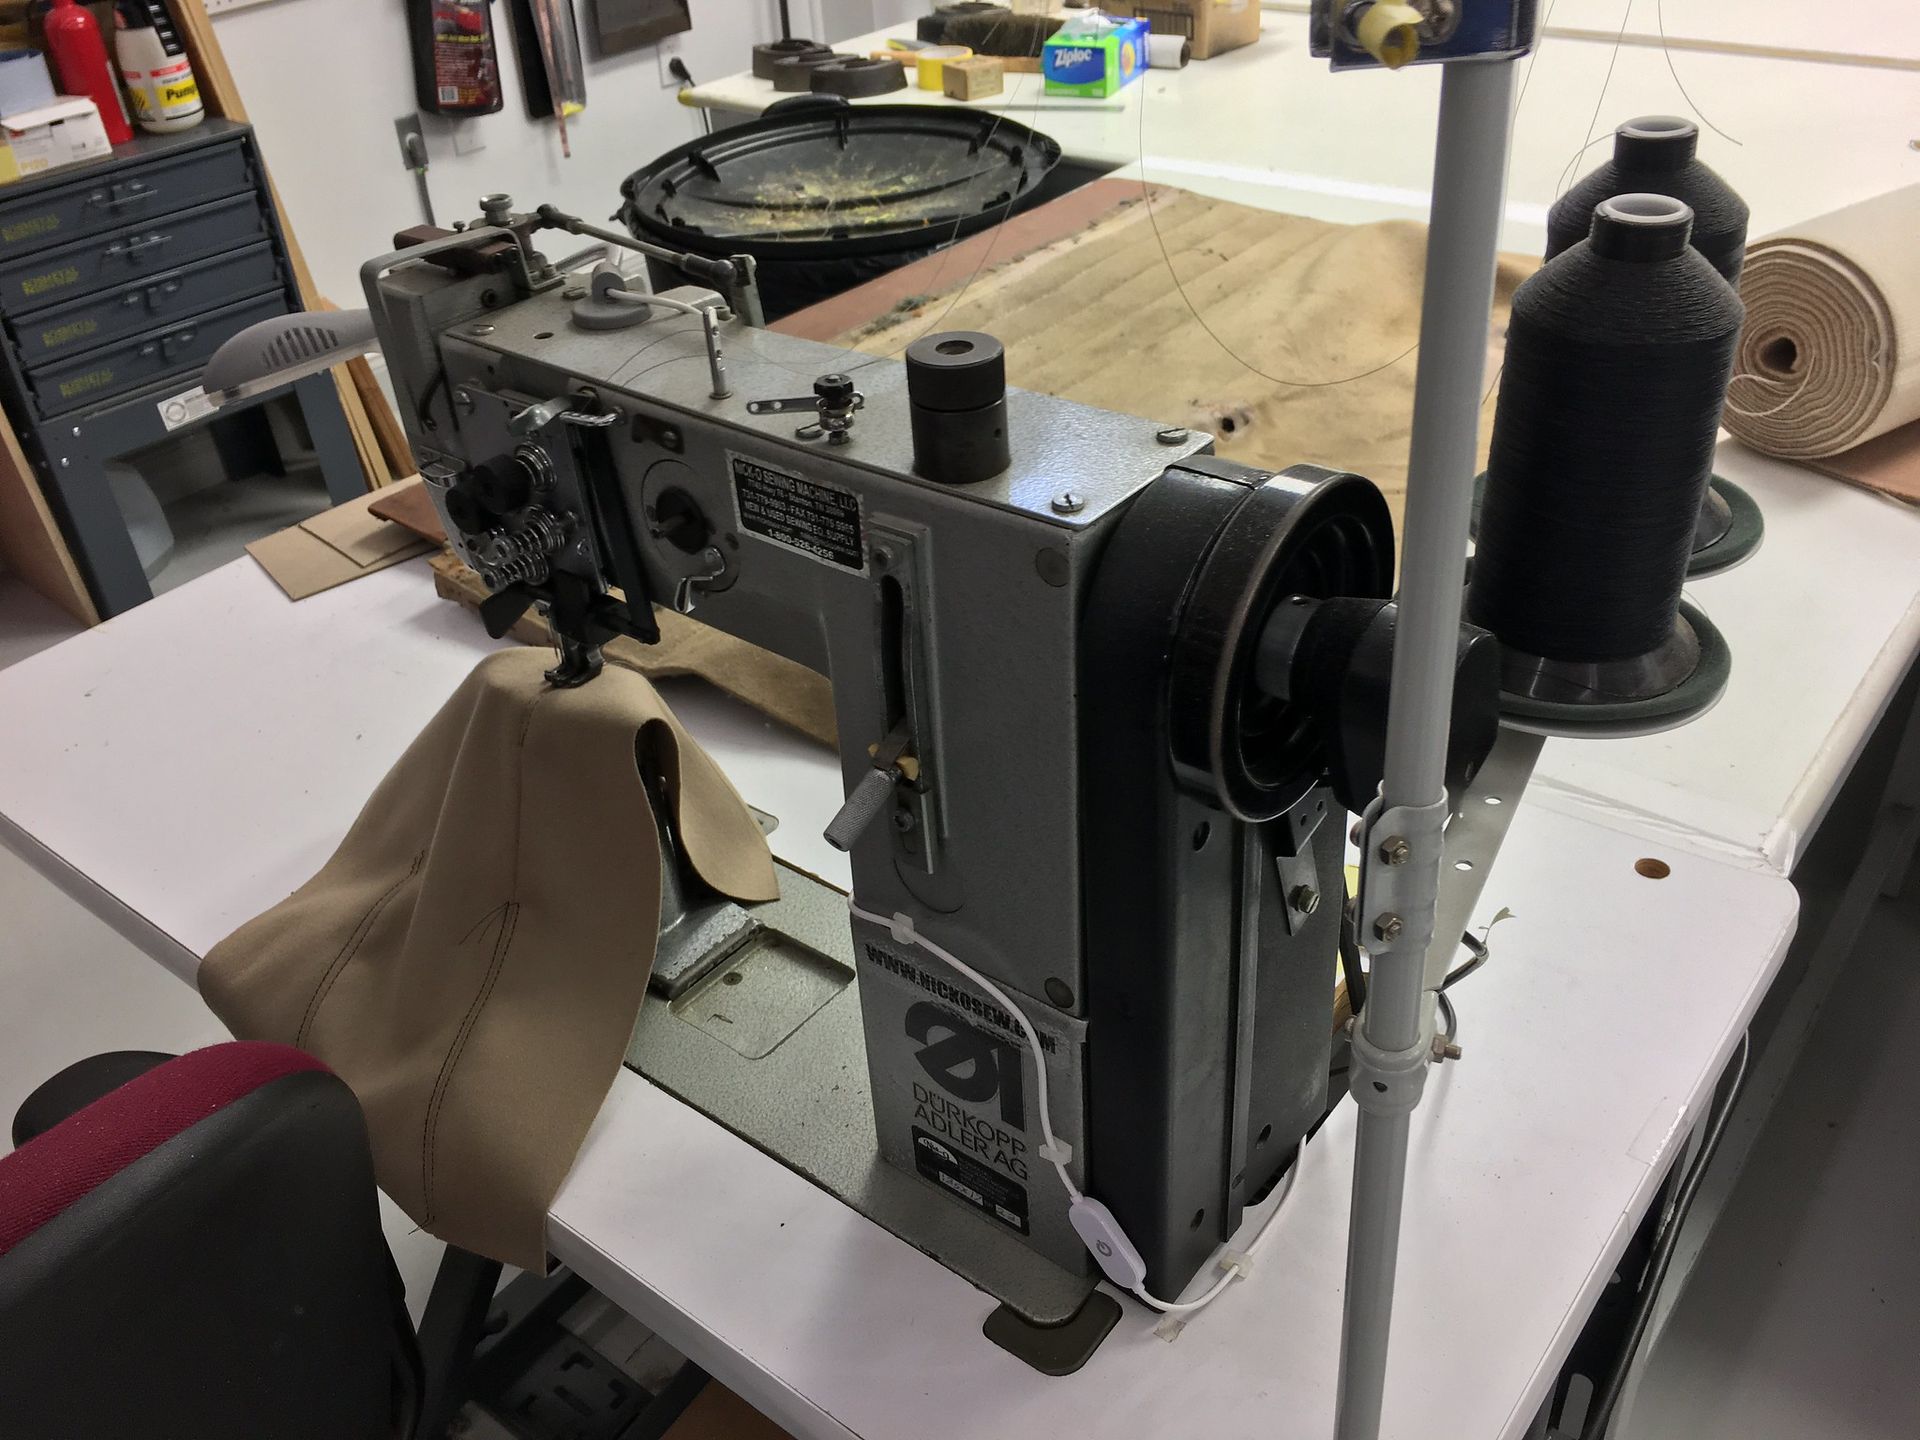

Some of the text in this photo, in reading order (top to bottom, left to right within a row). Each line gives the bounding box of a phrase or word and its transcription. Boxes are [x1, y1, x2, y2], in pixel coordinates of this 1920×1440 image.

[1054, 47, 1092, 68] Ziploc
[762, 470, 795, 492] SEWING
[838, 495, 857, 513] LLC
[790, 505, 805, 517] FAX
[744, 500, 759, 513] NEW
[760, 506, 766, 515] &
[766, 508, 785, 522] USED
[785, 514, 812, 531] SEWING
[826, 529, 855, 547] SUPPLY
[864, 943, 1057, 1055] WWW.NICKOSEW.CM
[912, 1081, 1027, 1155] DÜRKOPP
[914, 1103, 1028, 1181] ADLER AG
